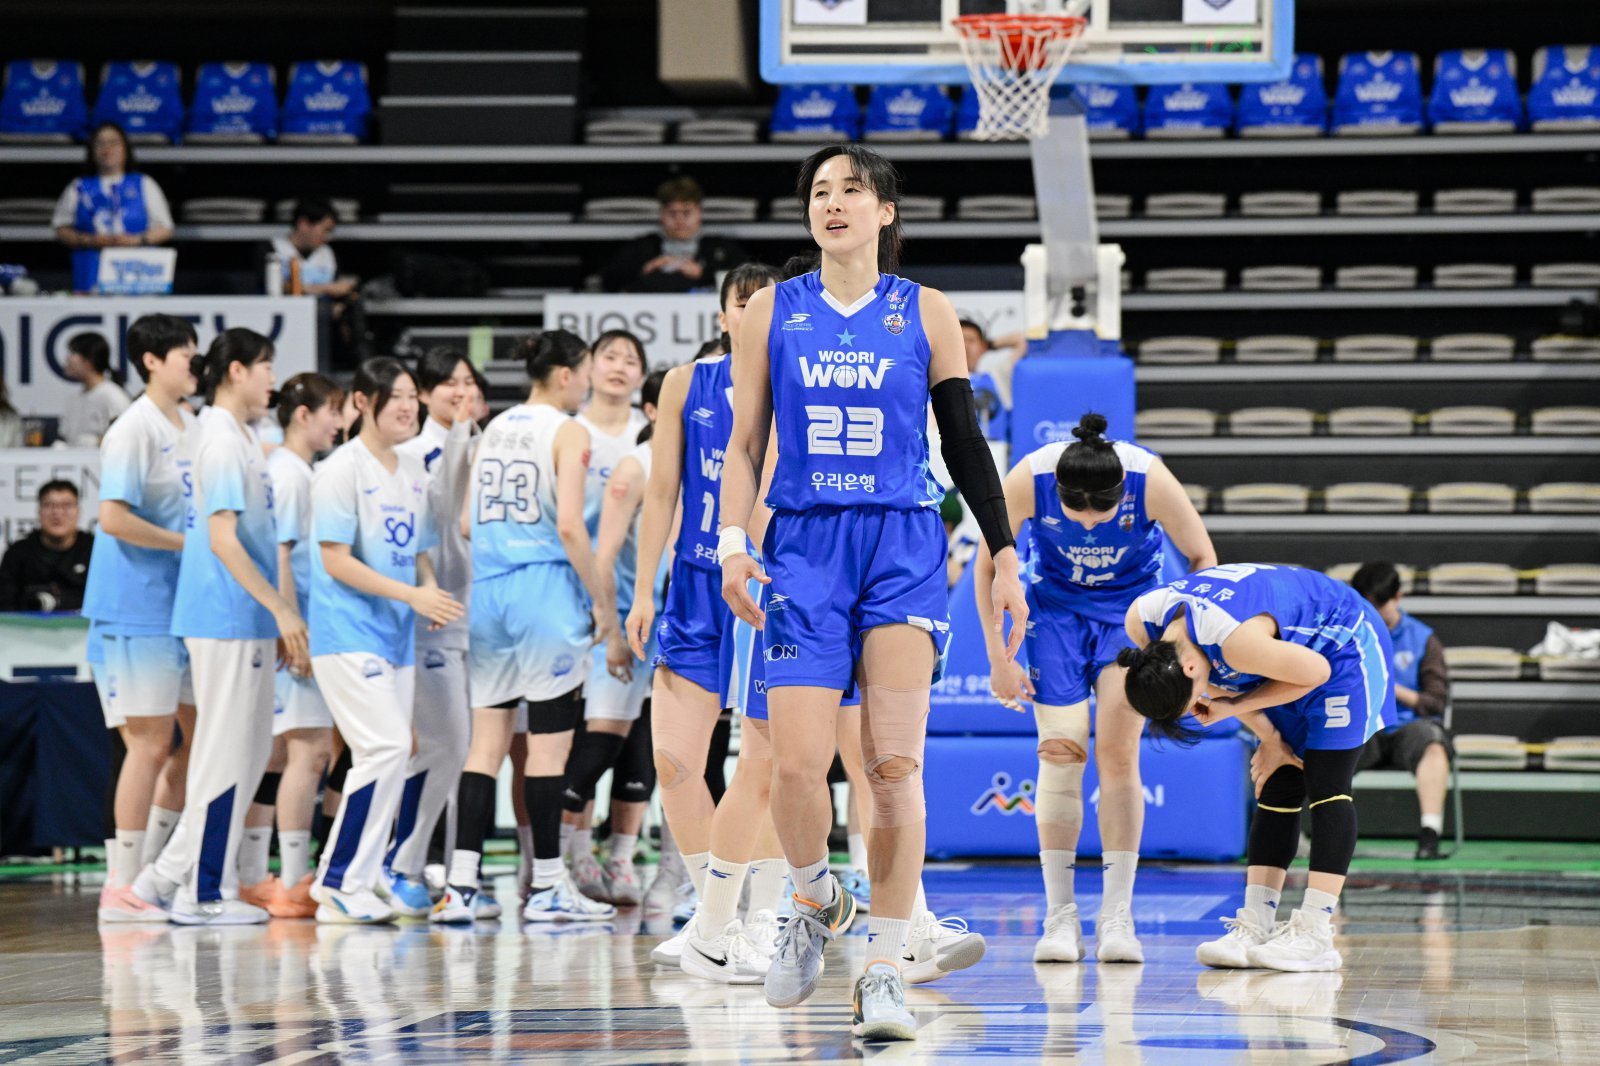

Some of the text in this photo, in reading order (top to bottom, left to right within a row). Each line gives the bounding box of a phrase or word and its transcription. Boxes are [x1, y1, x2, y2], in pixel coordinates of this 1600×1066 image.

[558, 312, 656, 345] BIOS
[818, 350, 875, 364] WOORI
[798, 356, 897, 390] WON
[804, 405, 884, 457] 23
[477, 458, 542, 525] 23
[811, 471, 875, 493] 우리은행
[694, 543, 722, 566] 우리
[1057, 545, 1130, 569] WON
[1069, 545, 1114, 555] WOORI
[1324, 694, 1351, 728] 5
